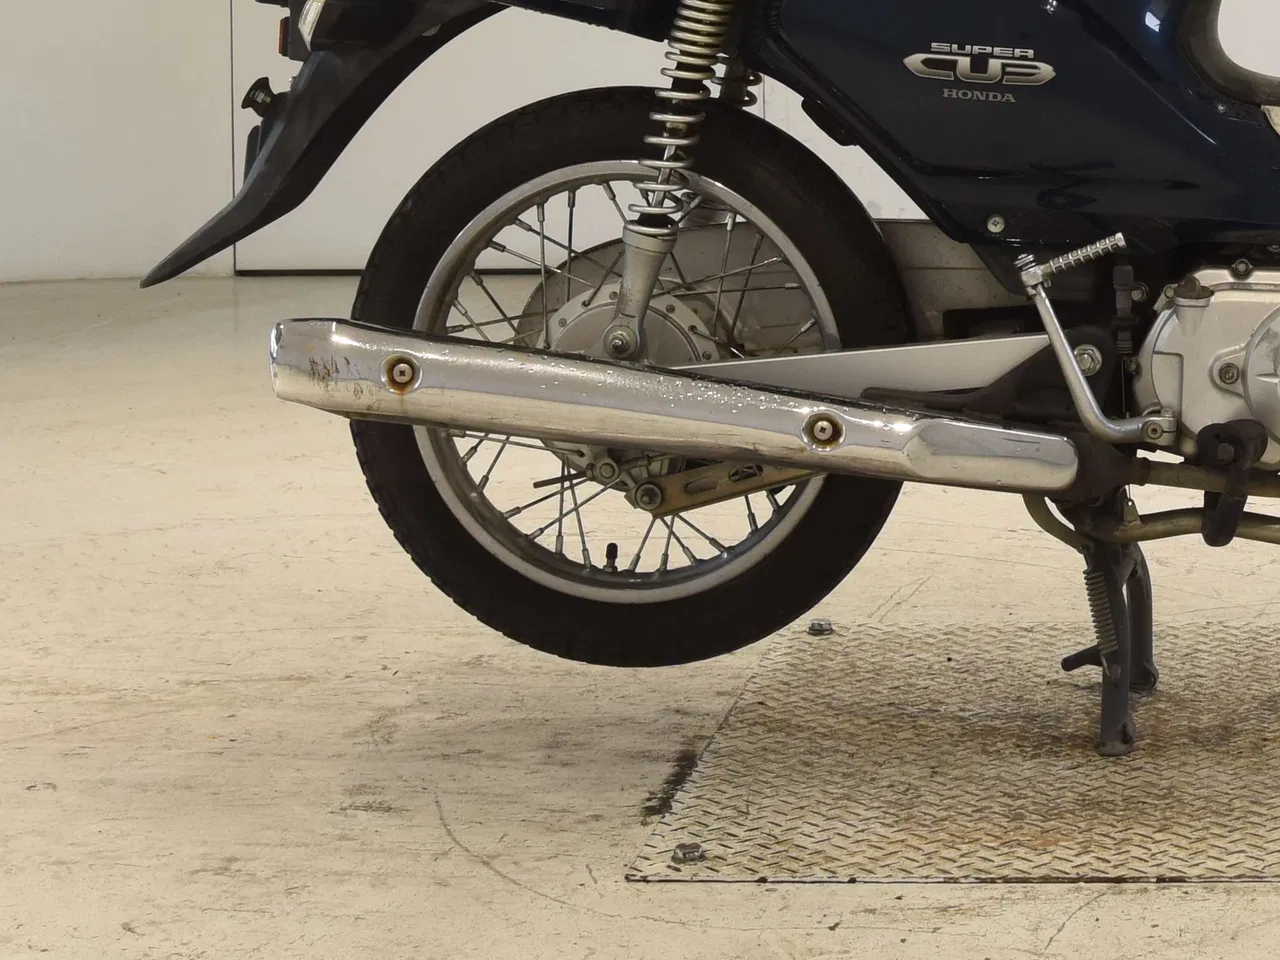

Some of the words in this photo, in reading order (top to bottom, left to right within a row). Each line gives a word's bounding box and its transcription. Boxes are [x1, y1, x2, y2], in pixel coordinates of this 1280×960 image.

[930, 42, 1035, 58] SUPER
[902, 53, 1057, 86] CUB
[942, 88, 1018, 103] HONDA
